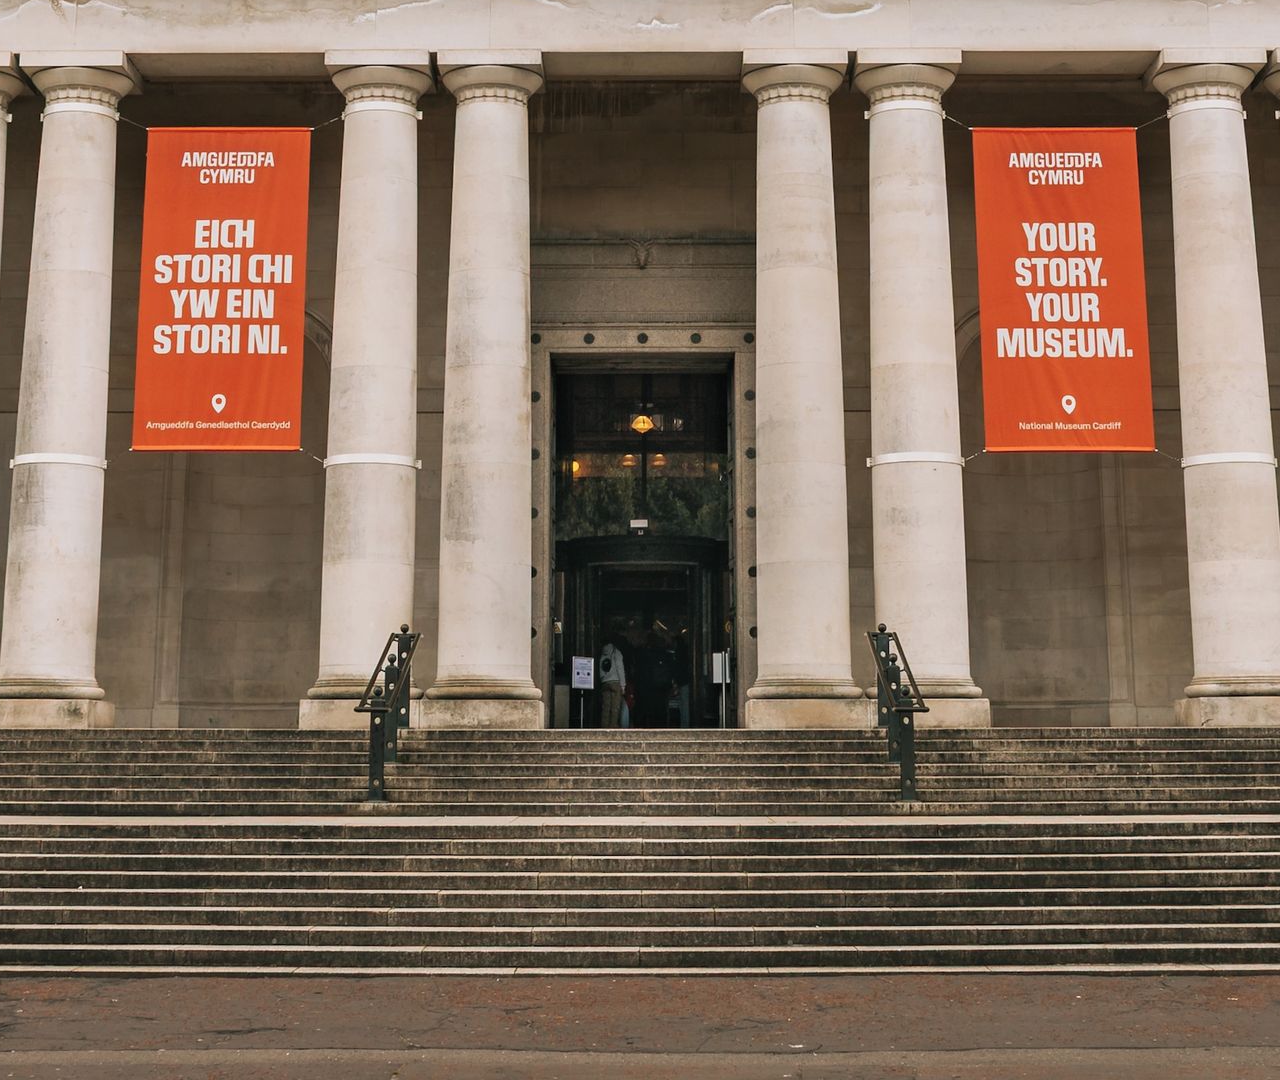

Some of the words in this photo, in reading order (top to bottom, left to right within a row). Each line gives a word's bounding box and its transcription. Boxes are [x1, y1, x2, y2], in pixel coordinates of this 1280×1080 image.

[181, 151, 275, 168] AMGUEDDFA
[1008, 152, 1103, 168] AMGUEDDFA
[199, 168, 256, 184] CYMRU
[1028, 169, 1084, 185] CYMRU
[194, 219, 256, 249] EICH
[1021, 222, 1097, 252] YOUR
[154, 253, 241, 284] STORI
[247, 253, 293, 284] CHI
[1014, 257, 1108, 287] STORY.
[170, 289, 220, 319] YW
[226, 289, 275, 319] EIN
[1025, 292, 1100, 323] YOUR
[152, 324, 241, 355] STORI
[247, 324, 288, 355] NI.
[996, 327, 1134, 358] MUSEUM.
[146, 421, 194, 431] Amgueddfa
[195, 421, 250, 430] Genedlaethol
[251, 421, 291, 431] Caerdydd
[1018, 421, 1054, 430] National
[1055, 421, 1091, 430] Museum
[1092, 421, 1121, 430] Cardiff
